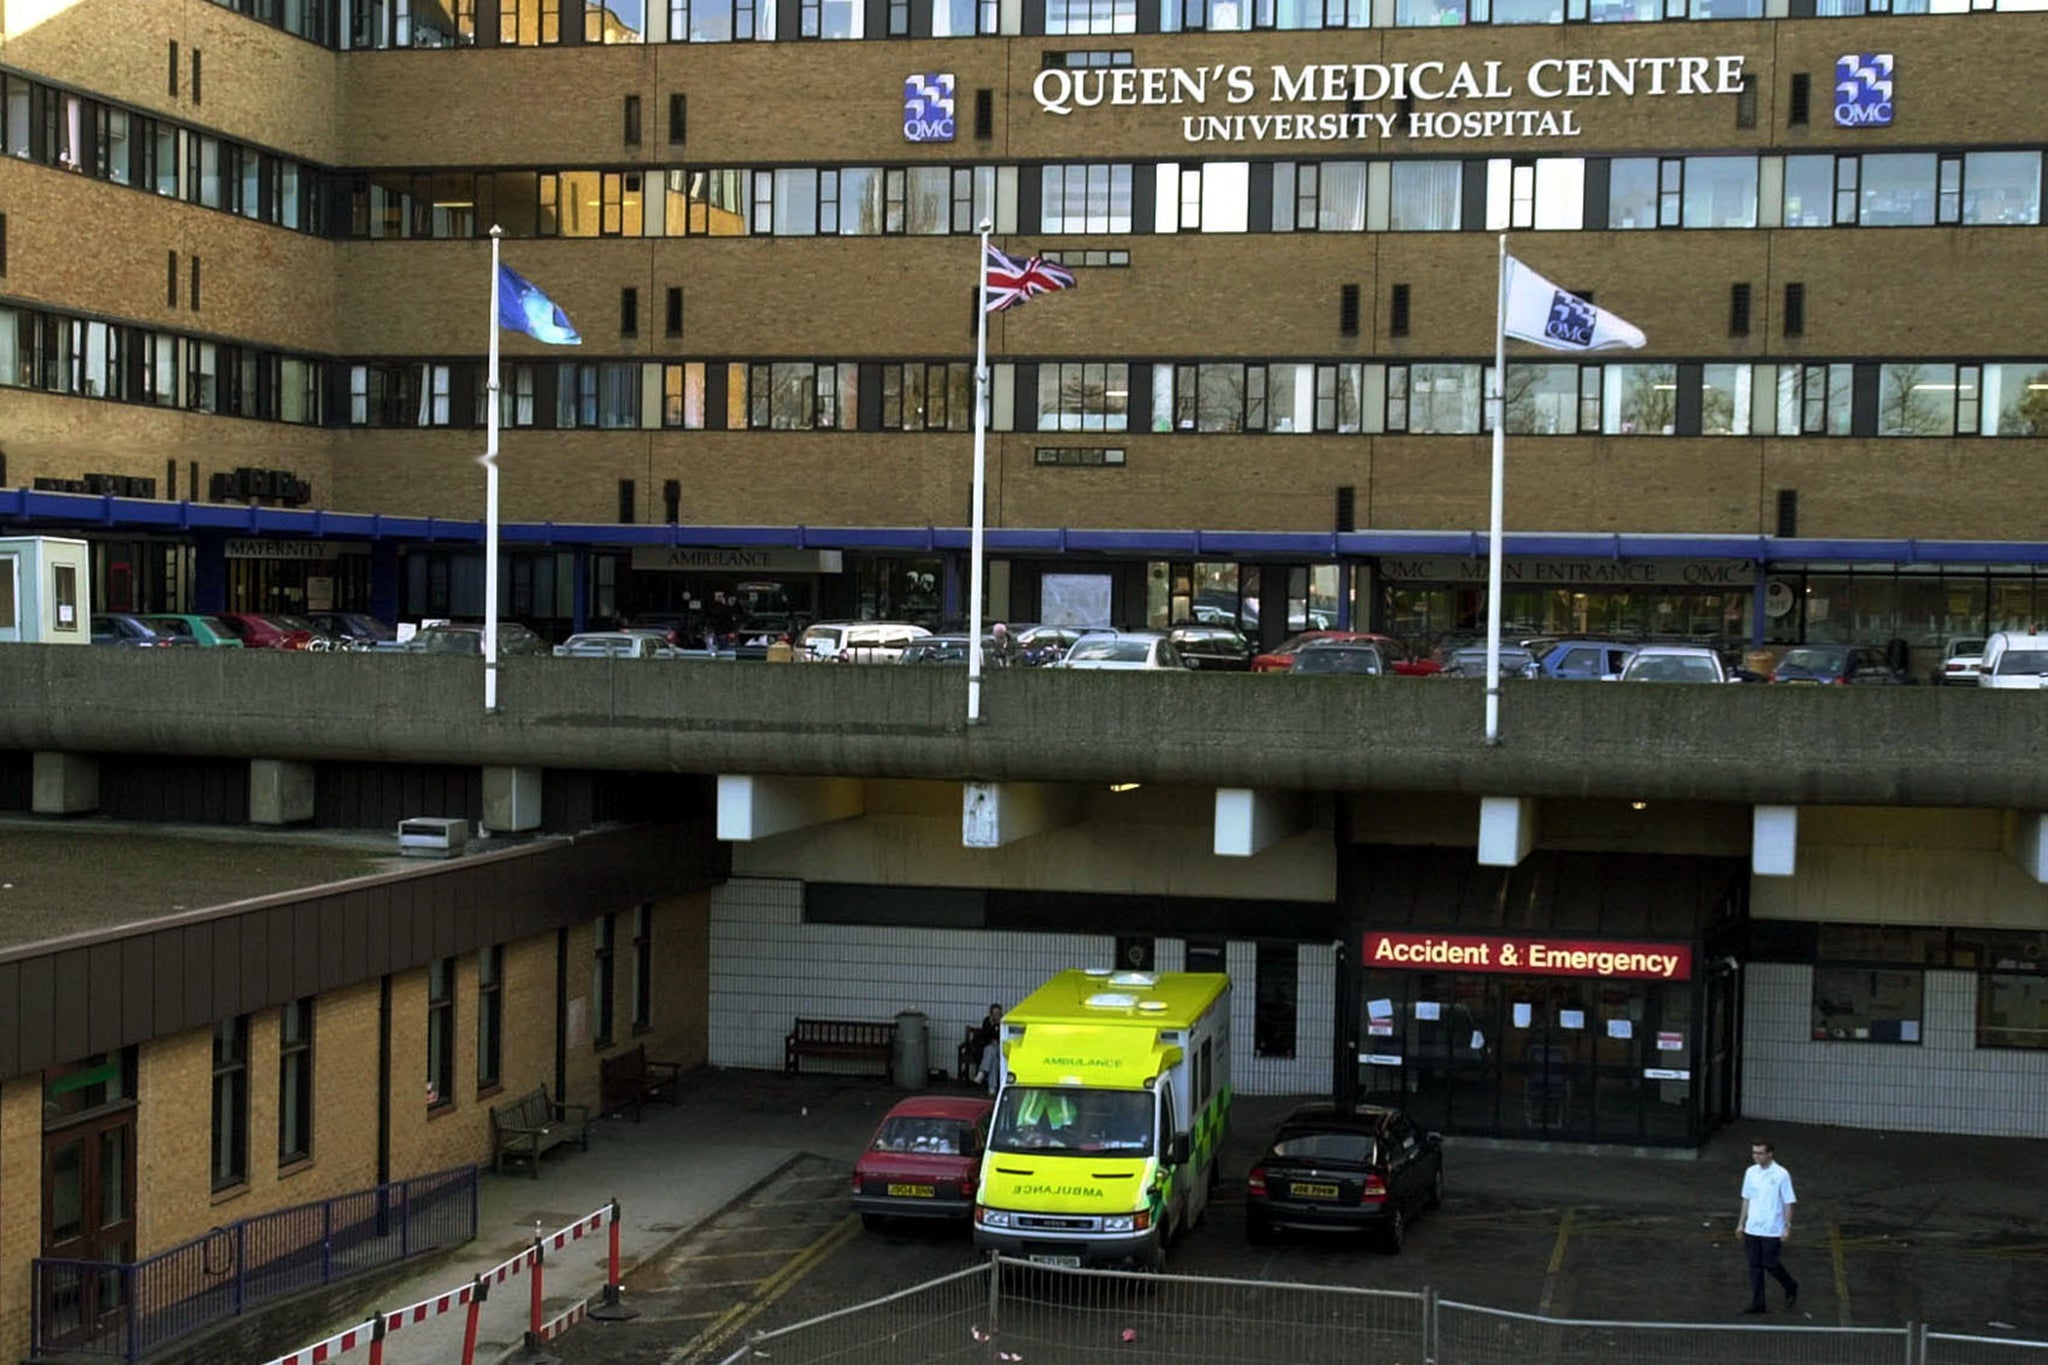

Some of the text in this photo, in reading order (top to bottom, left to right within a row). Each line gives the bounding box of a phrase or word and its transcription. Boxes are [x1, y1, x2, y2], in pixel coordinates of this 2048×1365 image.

[1033, 55, 1744, 114] QUEEN'S MEDICAL CENTRE
[1182, 109, 1581, 141] UNIVERSITY HOSPITAL
[1834, 102, 1892, 126] QMC
[904, 119, 953, 141] QMC
[1547, 319, 1590, 343] QMC
[230, 540, 326, 556] MATERNITY
[668, 551, 772, 567] AMBULANCE
[1535, 562, 1654, 582] ENTRANCE
[1375, 938, 1678, 977] Accident & Emergency
[1043, 1057, 1122, 1068] AMBULANCE
